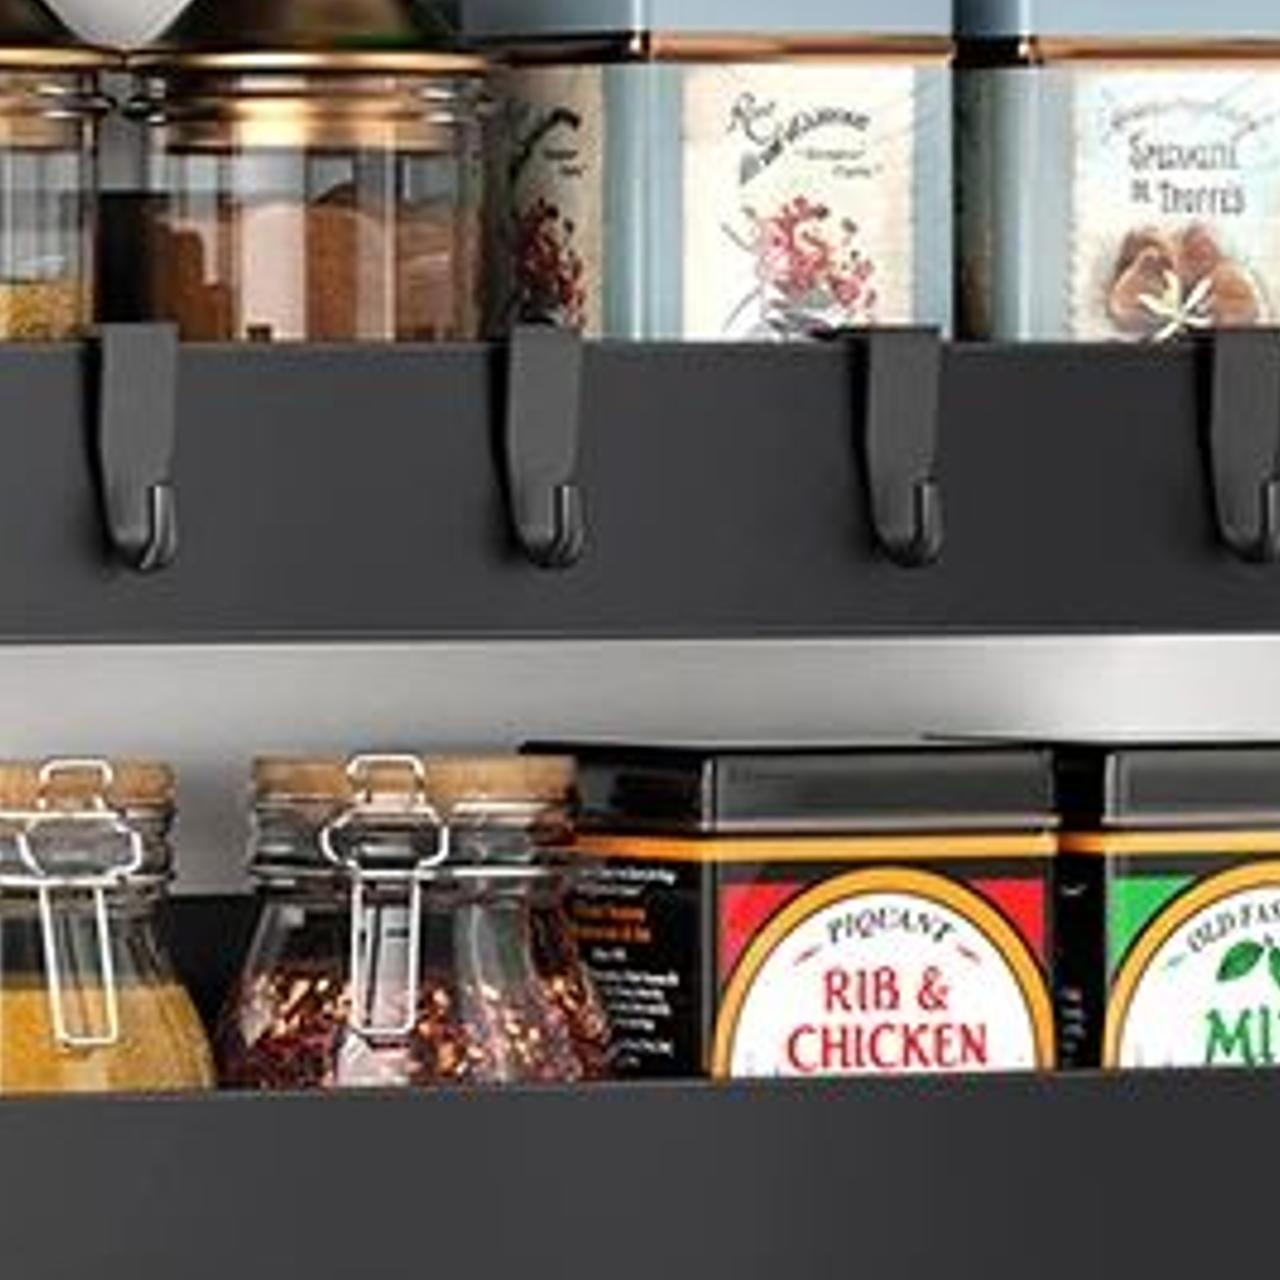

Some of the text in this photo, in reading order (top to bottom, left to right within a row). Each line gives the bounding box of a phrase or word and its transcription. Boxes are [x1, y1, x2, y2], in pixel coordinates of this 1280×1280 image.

[826, 906, 956, 944] PIQUANT
[1187, 912, 1236, 953] OLD
[823, 965, 949, 1012] RIB &
[787, 1022, 988, 1072] CHICKEN
